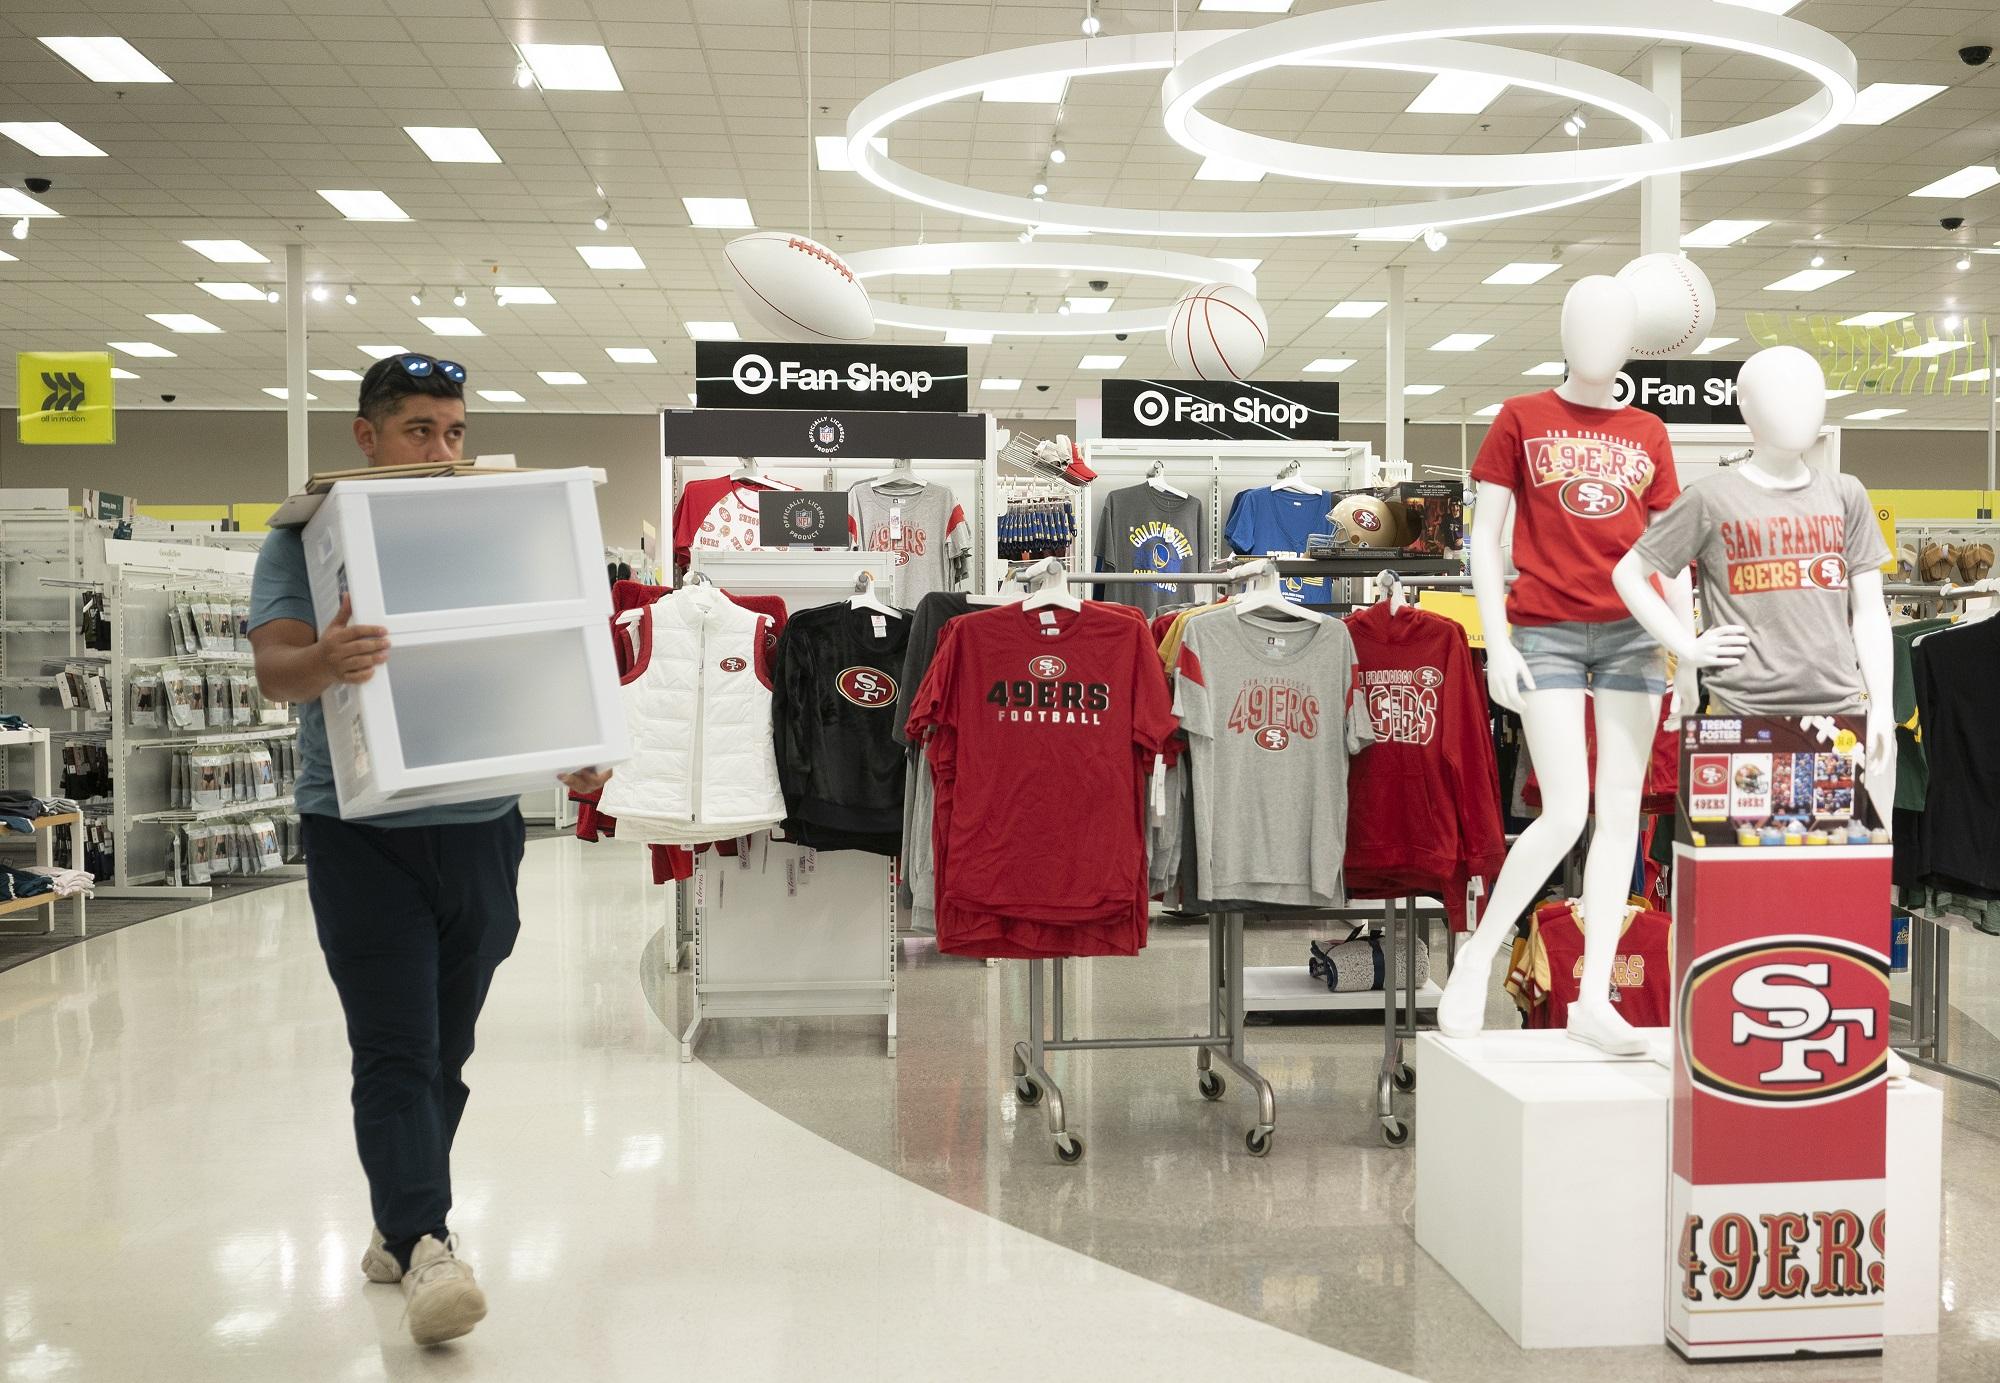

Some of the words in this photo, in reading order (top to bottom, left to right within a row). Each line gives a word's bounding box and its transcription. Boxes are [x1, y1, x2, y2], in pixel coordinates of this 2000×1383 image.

[780, 361, 838, 391] Fan
[847, 362, 932, 398] Shop
[1641, 378, 1696, 405] Fan
[1703, 378, 1739, 405] Sh
[1174, 397, 1225, 423] Fan
[1233, 397, 1308, 429] Shop
[809, 416, 828, 443] OFFICIALLY
[830, 417, 845, 443] LICENSED
[814, 444, 840, 453] PRODUCT
[1536, 444, 1648, 485] 49ERS
[1578, 483, 1614, 512] SF
[783, 498, 805, 528] OFFICIALLY
[808, 499, 825, 528] LICENSED
[789, 530, 819, 540] PRODUCT
[1129, 521, 1168, 548] GOLDEN
[1721, 519, 1762, 560] SAN
[1767, 515, 1845, 556] FRANCIS
[1734, 561, 1797, 591] 49ERS
[726, 658, 742, 671] SF
[1040, 659, 1059, 676] SF
[1366, 670, 1413, 685] FRANCISCO
[854, 672, 887, 702] SF
[987, 681, 1109, 711] 49ERS
[998, 710, 1101, 725] FOOTBALL
[1228, 685, 1319, 739] 49ERS
[1361, 685, 1437, 745] 9ERS
[1700, 719, 1742, 730] TRENDS
[1266, 729, 1286, 748] SF
[1700, 730, 1742, 739] POSTERS
[1694, 799, 1725, 809] 49ERS
[1737, 797, 1764, 808] 49ERS
[1573, 955, 1645, 986] 4RS
[1732, 963, 1875, 1083] SF
